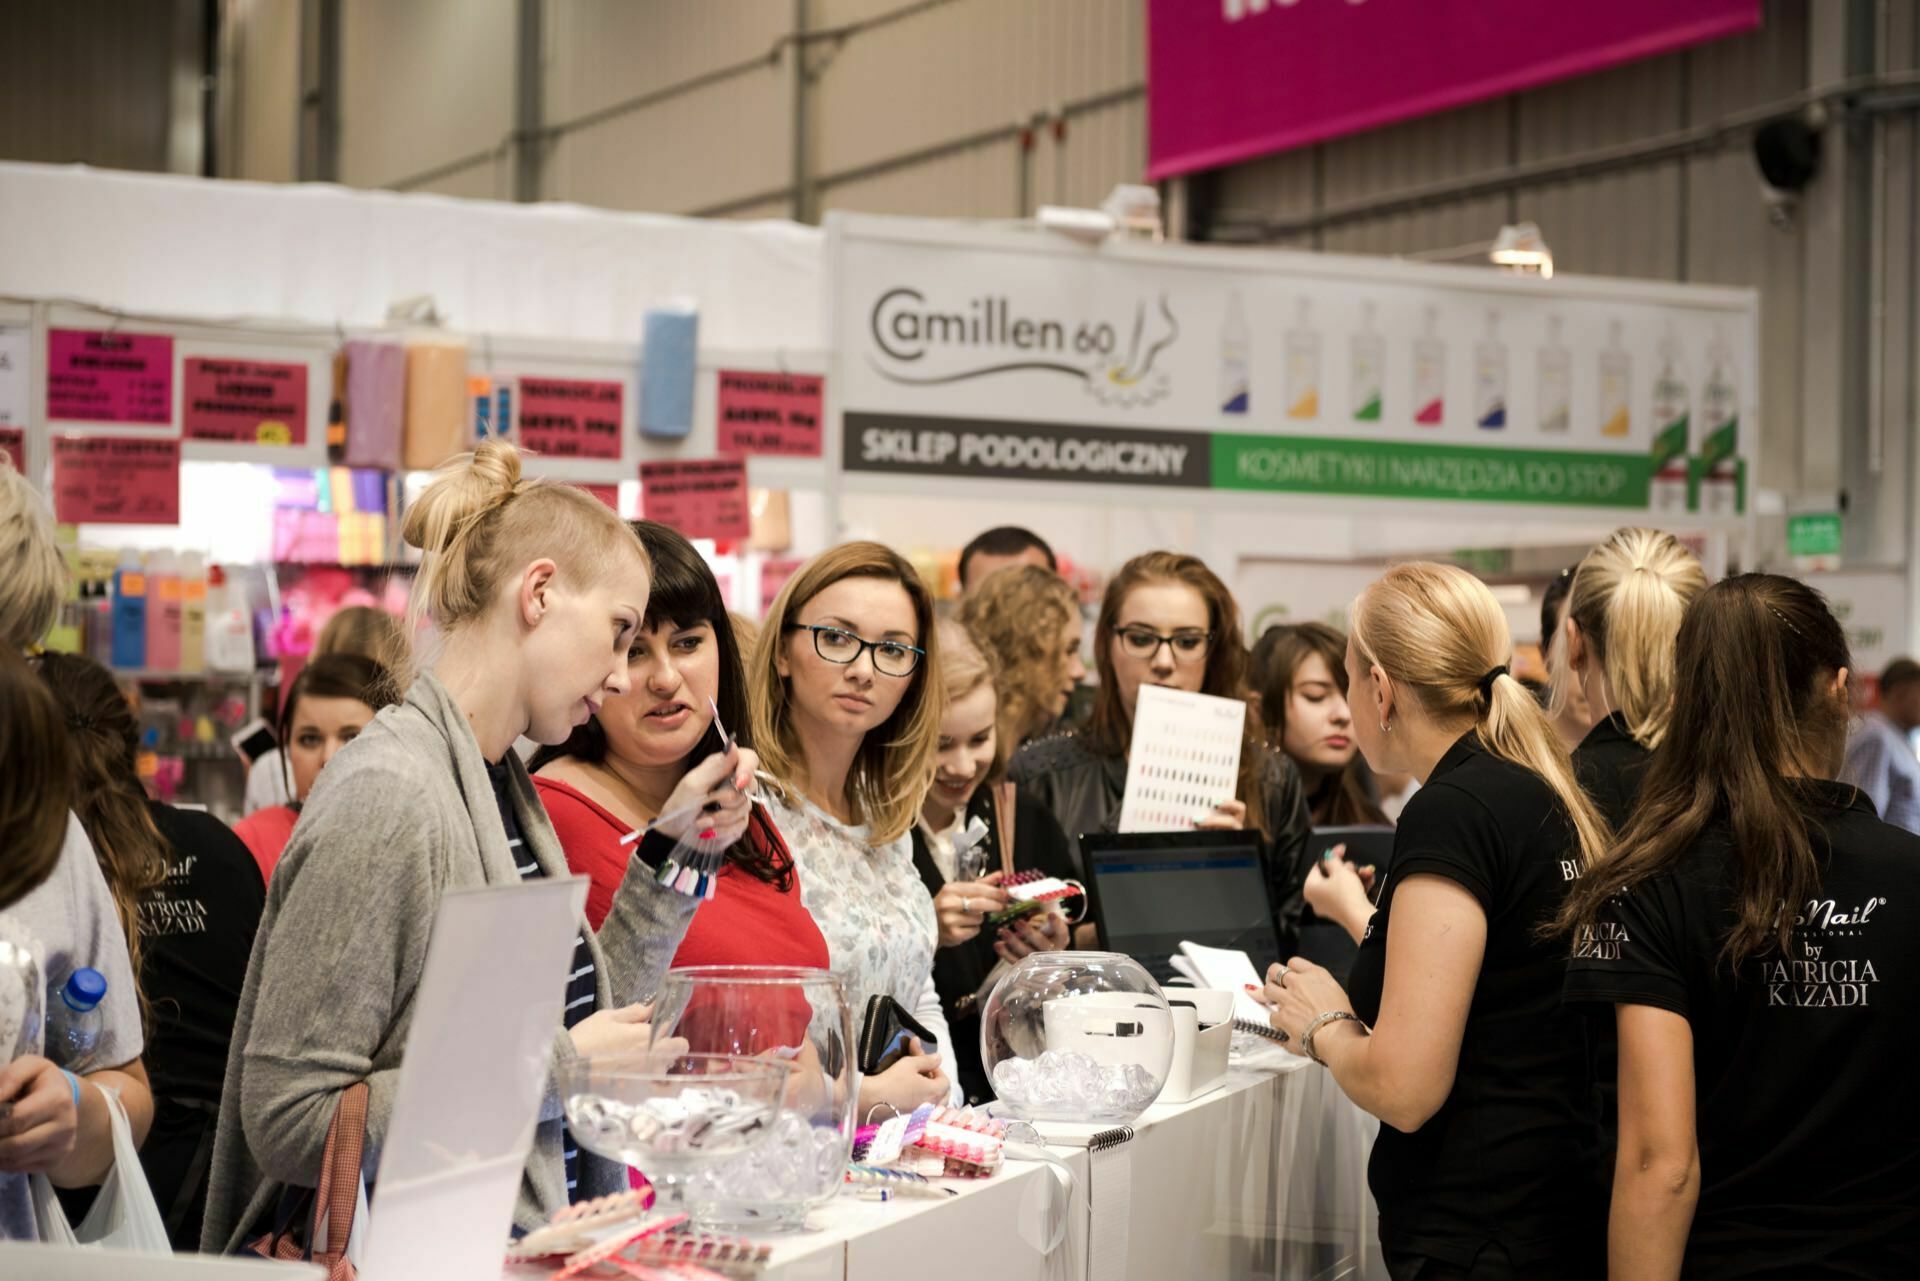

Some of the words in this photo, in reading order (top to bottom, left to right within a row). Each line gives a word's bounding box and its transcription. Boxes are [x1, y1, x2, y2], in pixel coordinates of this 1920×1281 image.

[871, 287, 1065, 362] Camillen
[1073, 320, 1117, 355] 60
[861, 427, 957, 463] SKLEP
[958, 432, 1188, 477] PODOLOGICZNY
[1236, 448, 1376, 486] KOSMETYKI
[1526, 460, 1566, 496] DO
[1804, 940, 1824, 961] by
[1767, 983, 1870, 1008] KAZADI
